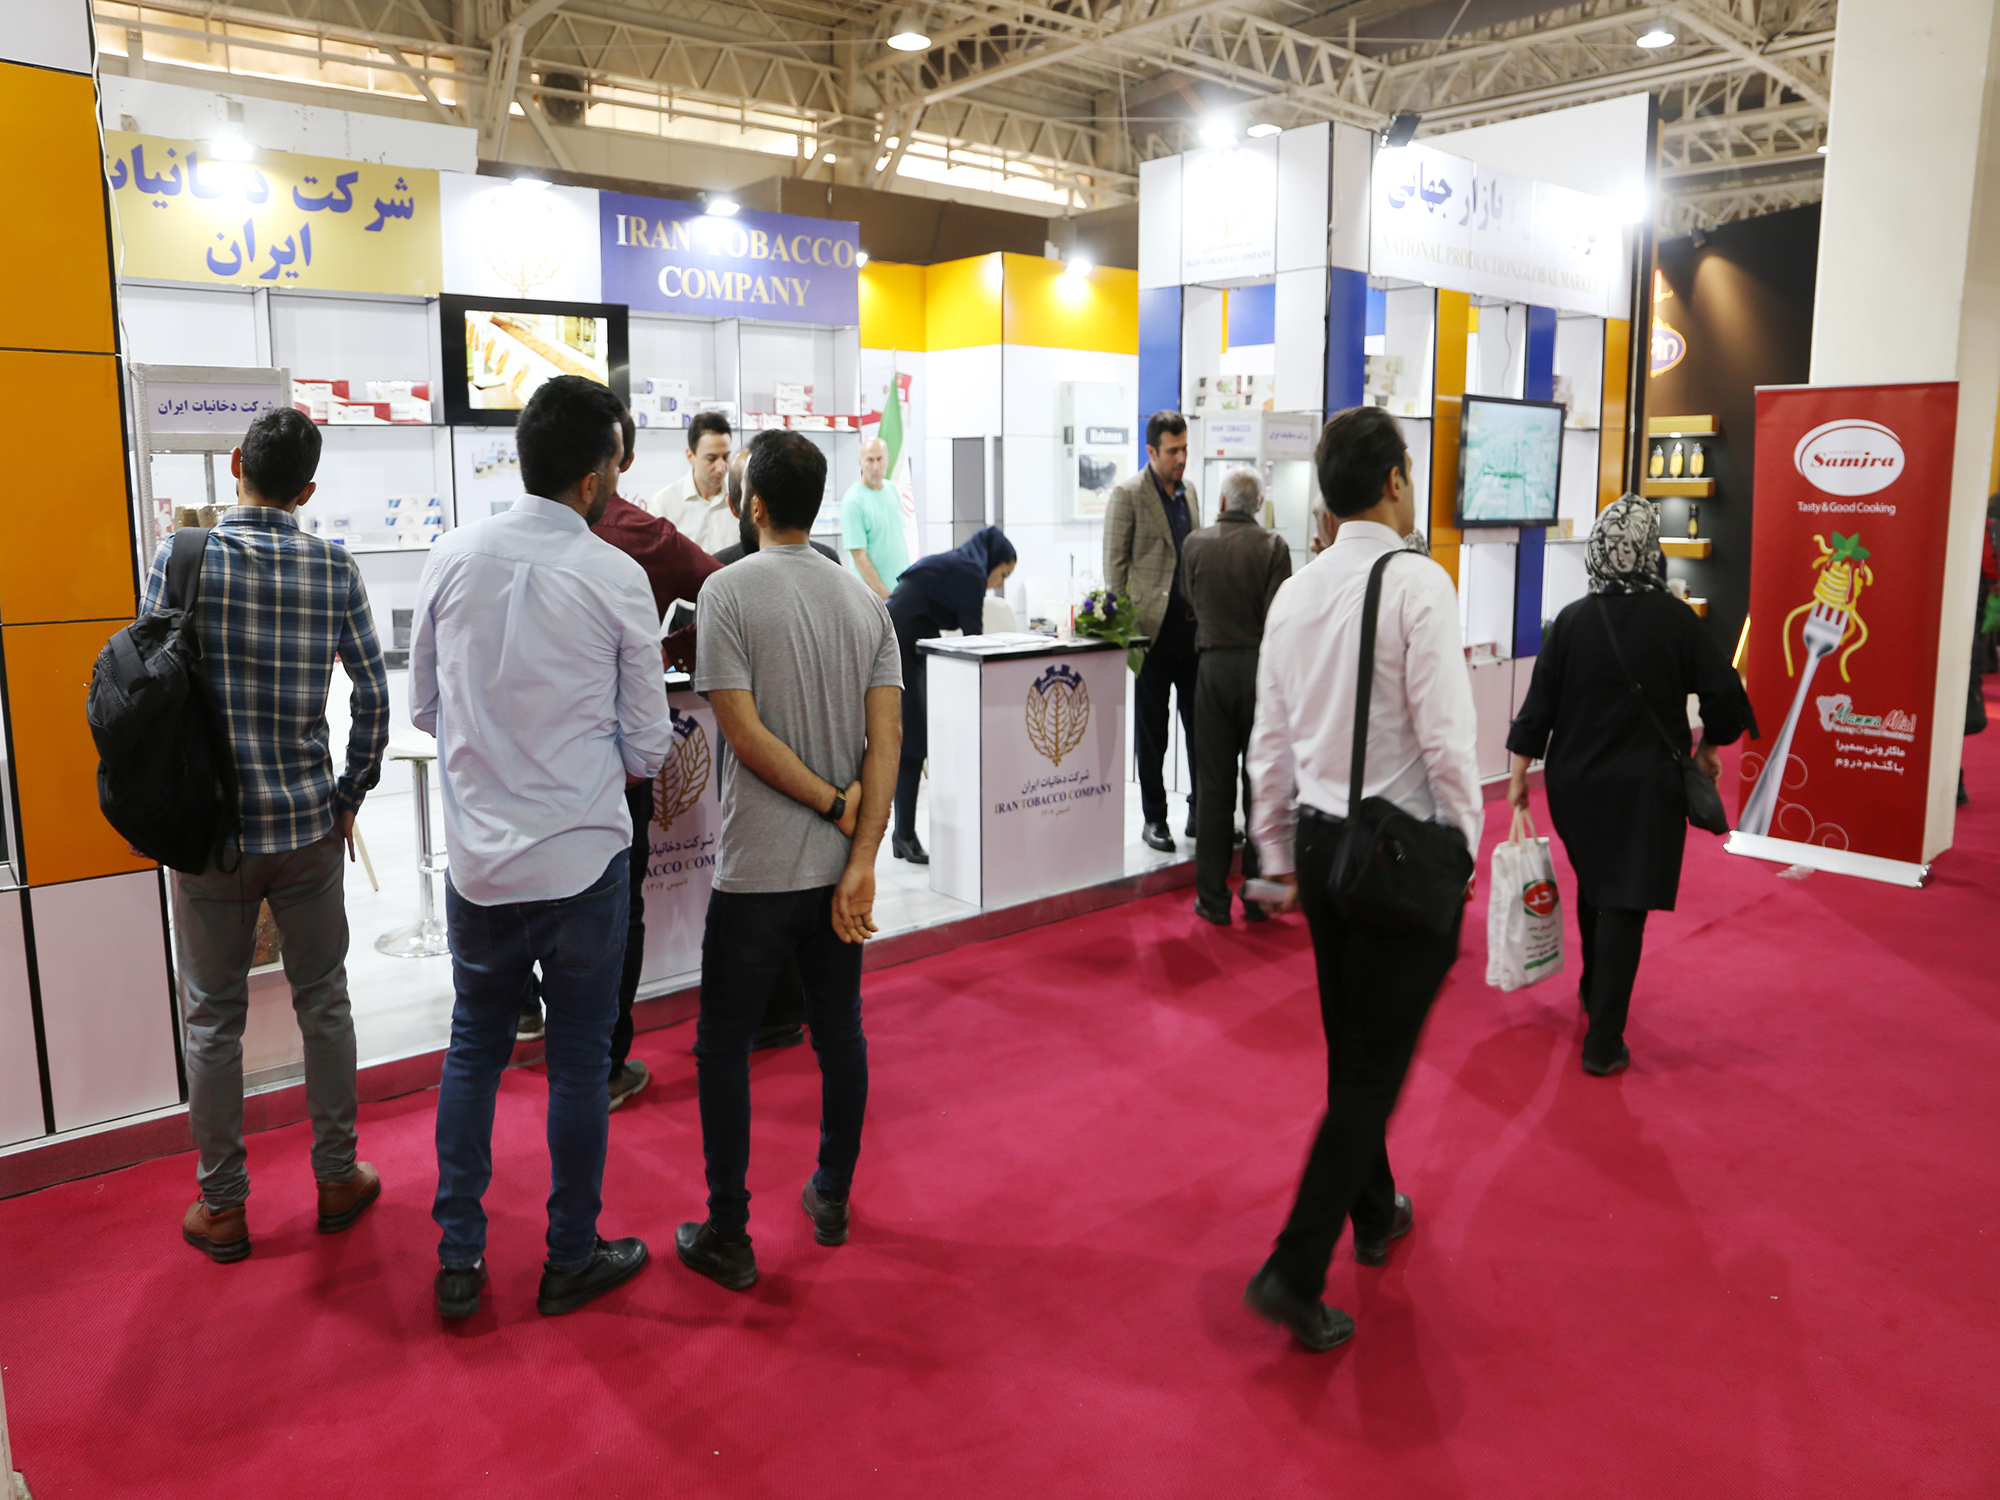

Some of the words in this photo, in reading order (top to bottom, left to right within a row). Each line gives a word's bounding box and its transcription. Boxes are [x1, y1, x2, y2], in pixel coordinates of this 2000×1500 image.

[293, 170, 414, 232] شرکت
[206, 217, 312, 280] ایران
[615, 214, 690, 252] IRAN
[1382, 232, 1445, 264] NATIONAL
[1561, 272, 1599, 295] MARKET
[658, 264, 810, 306] COMPANY
[157, 399, 189, 416] ایران
[191, 399, 238, 415] دخانیات
[1797, 500, 1821, 515] Tasty
[1829, 501, 1856, 513] Good
[1857, 502, 1897, 516] Cooking
[1068, 769, 1091, 784] شرکت
[994, 800, 1019, 814] IRAN
[1021, 791, 1067, 809] TOBACCO
[1068, 782, 1113, 800] COMPANY
[683, 832, 715, 851] شرکت
